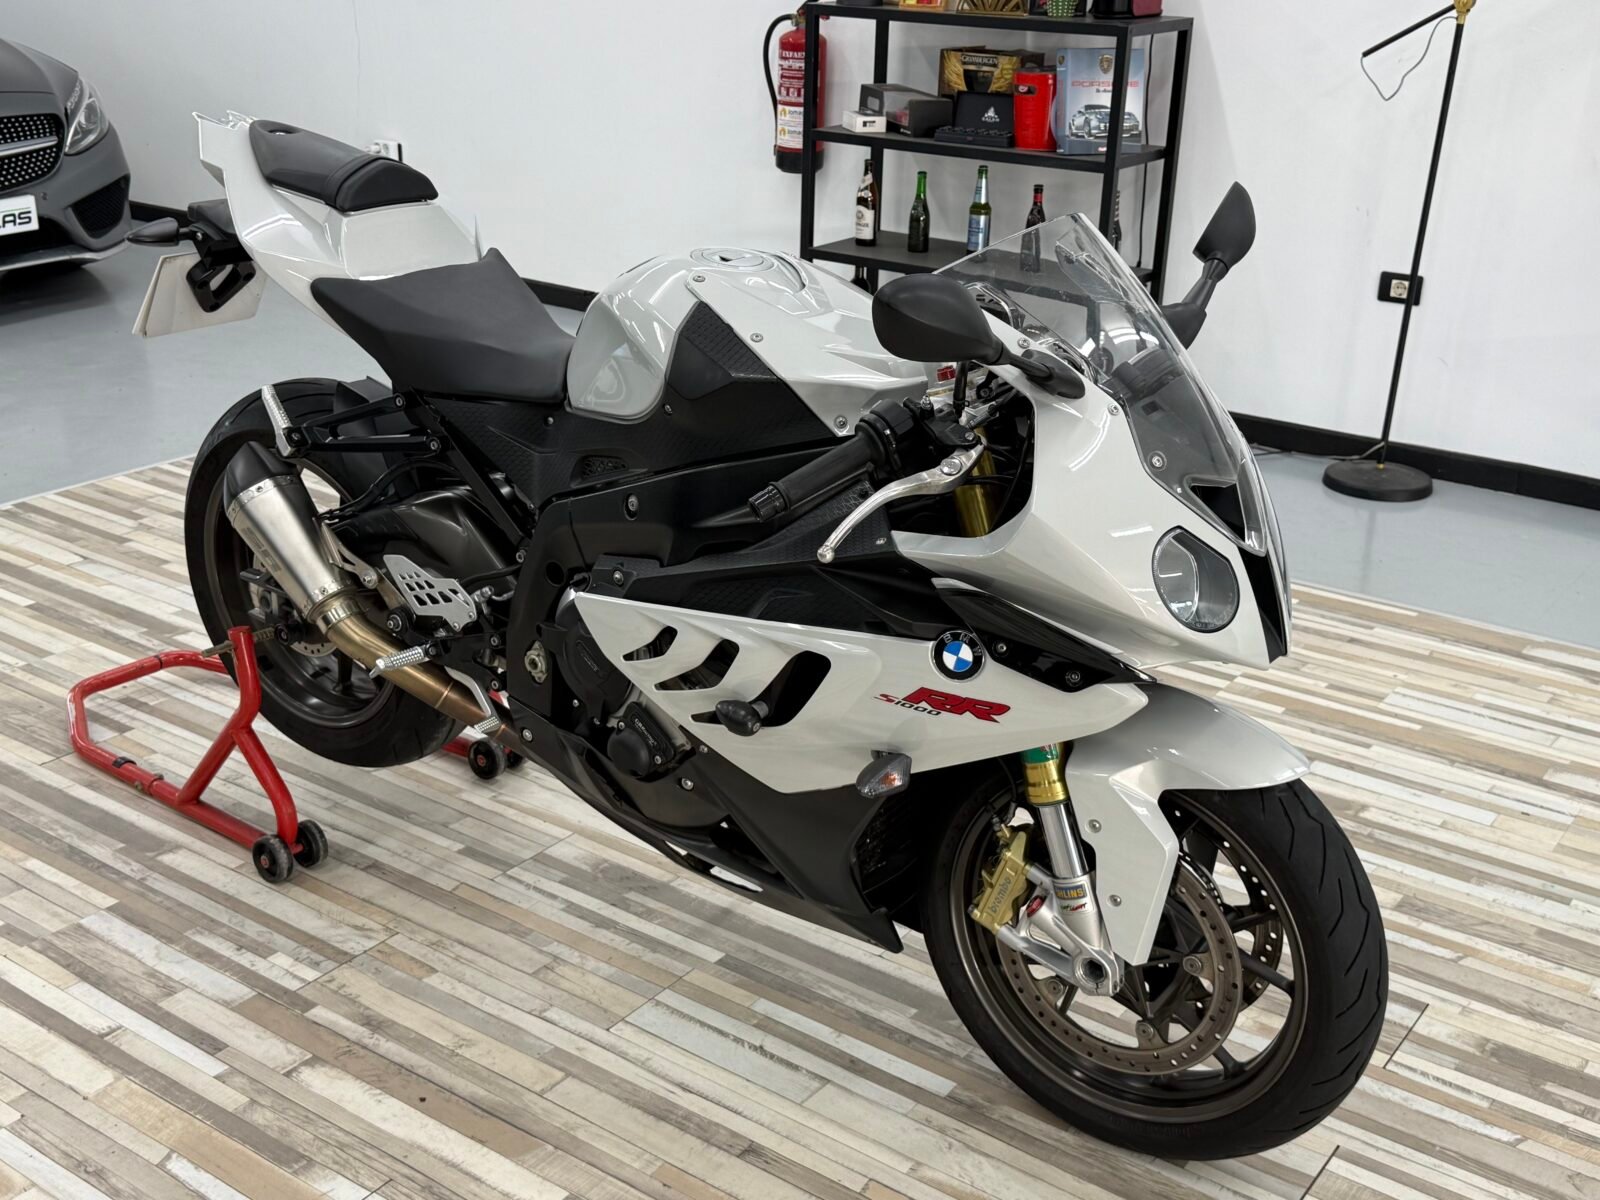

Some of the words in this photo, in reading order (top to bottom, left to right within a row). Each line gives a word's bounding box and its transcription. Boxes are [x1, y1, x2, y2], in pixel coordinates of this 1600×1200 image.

[0, 210, 32, 229] AS
[943, 632, 982, 657] BMW
[873, 693, 942, 716] S1000
[901, 686, 1011, 723] RR
